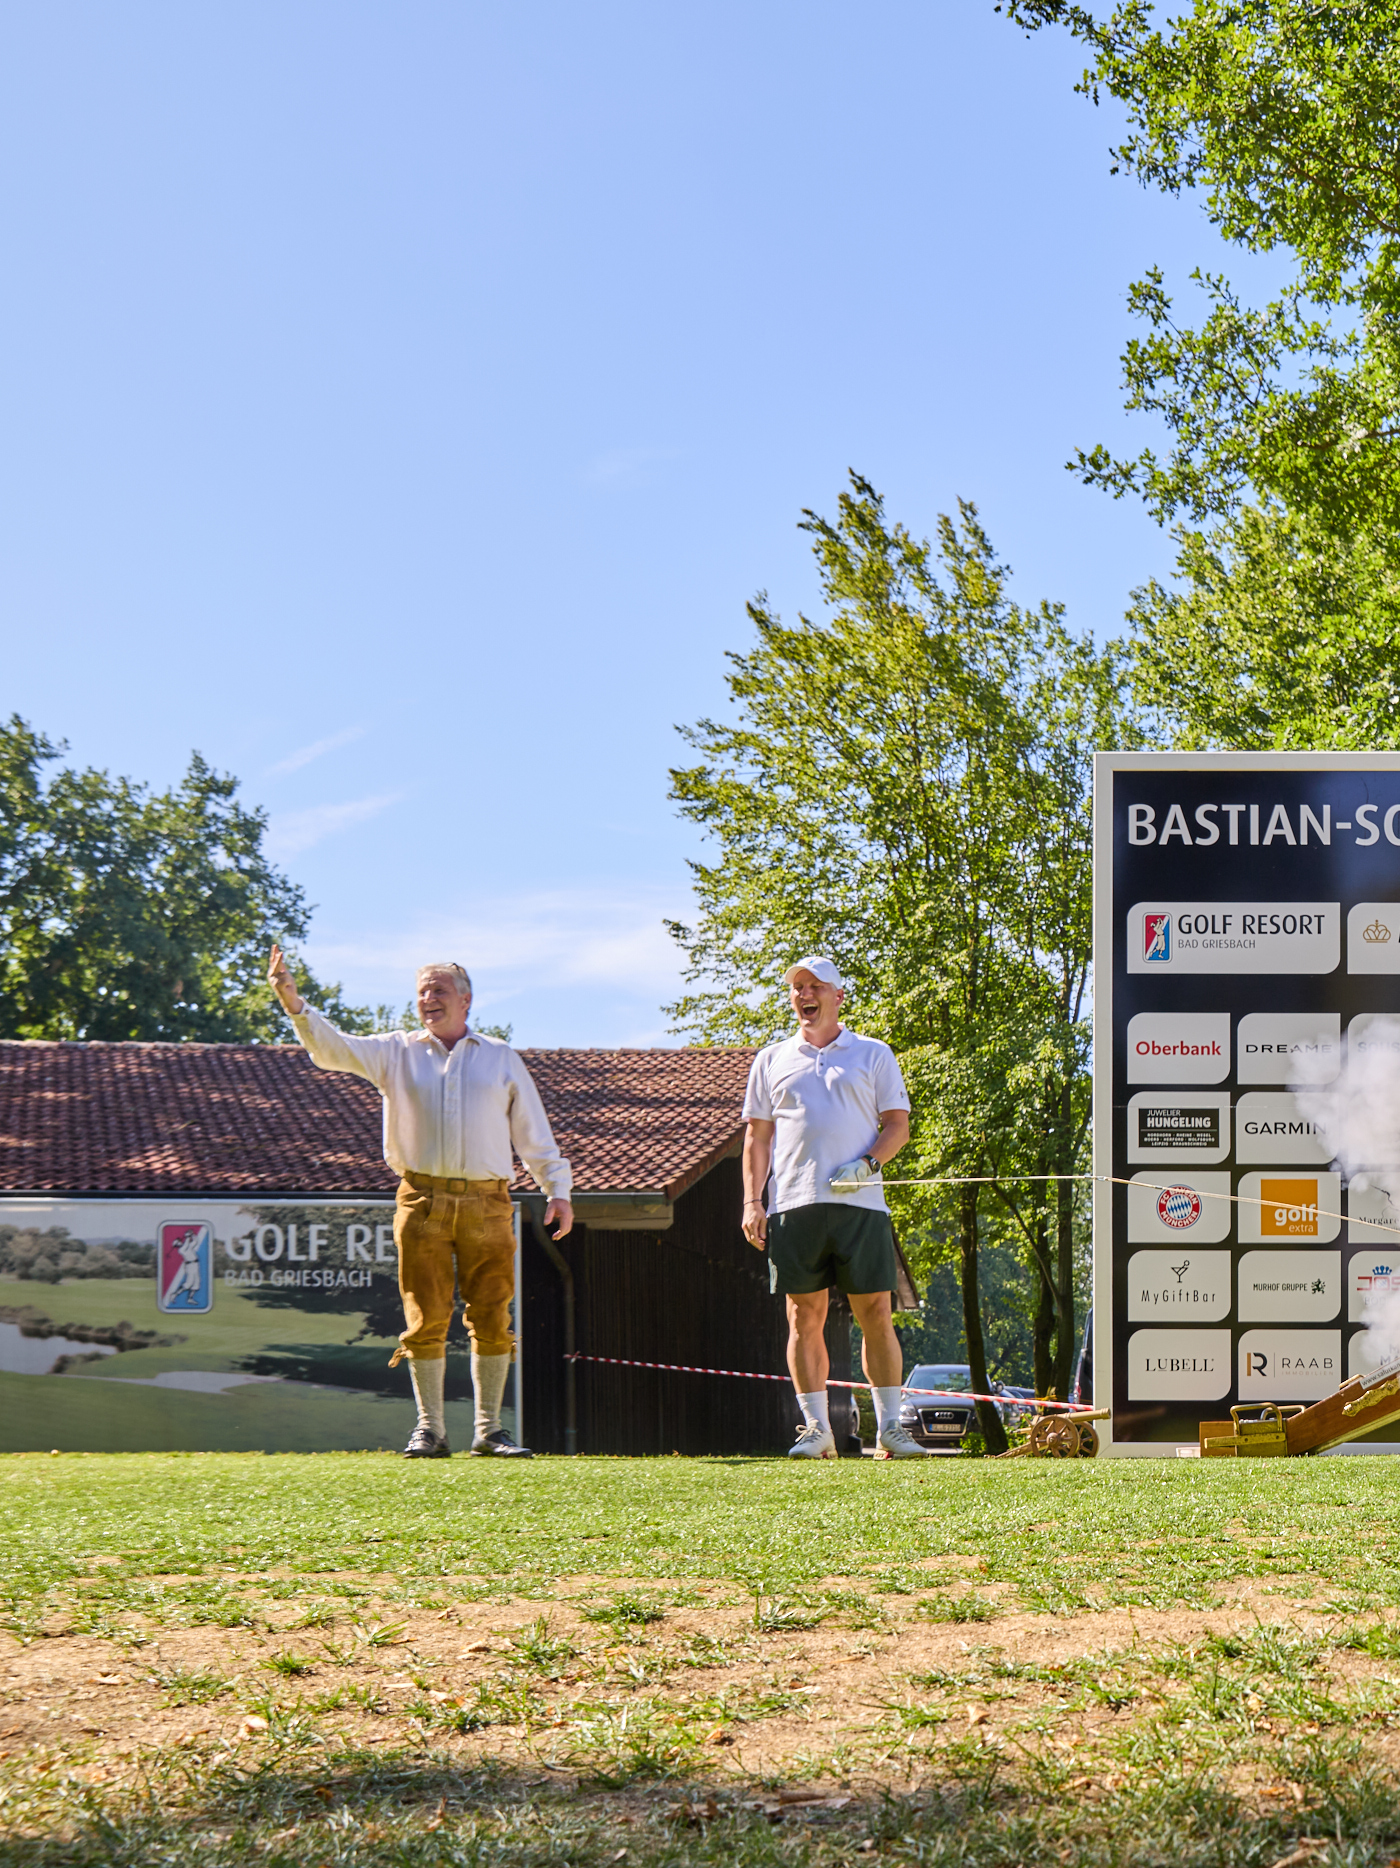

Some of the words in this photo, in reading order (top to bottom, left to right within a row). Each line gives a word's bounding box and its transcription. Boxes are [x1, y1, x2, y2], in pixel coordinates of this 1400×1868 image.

[1177, 914, 1233, 935] GOLF
[1242, 914, 1325, 935] RESORT
[1177, 939, 1199, 949] BAD
[1202, 939, 1256, 949] GRIESBACH
[1136, 1041, 1222, 1056] Oberbank
[1147, 1109, 1181, 1117] JUWELIER
[1147, 1117, 1211, 1128] HUNGELING
[1244, 1122, 1326, 1135] GARMIN
[1288, 1224, 1314, 1232] extra
[224, 1224, 329, 1263] GOLF
[224, 1269, 264, 1288] BAD
[270, 1269, 372, 1288] GRIESBACH
[1253, 1283, 1281, 1291] MURHOF
[1282, 1283, 1308, 1291] GRUPPE
[1141, 1289, 1216, 1305] MyGiftBar
[1145, 1358, 1214, 1372] LUBELL
[1281, 1357, 1334, 1369] RAAB
